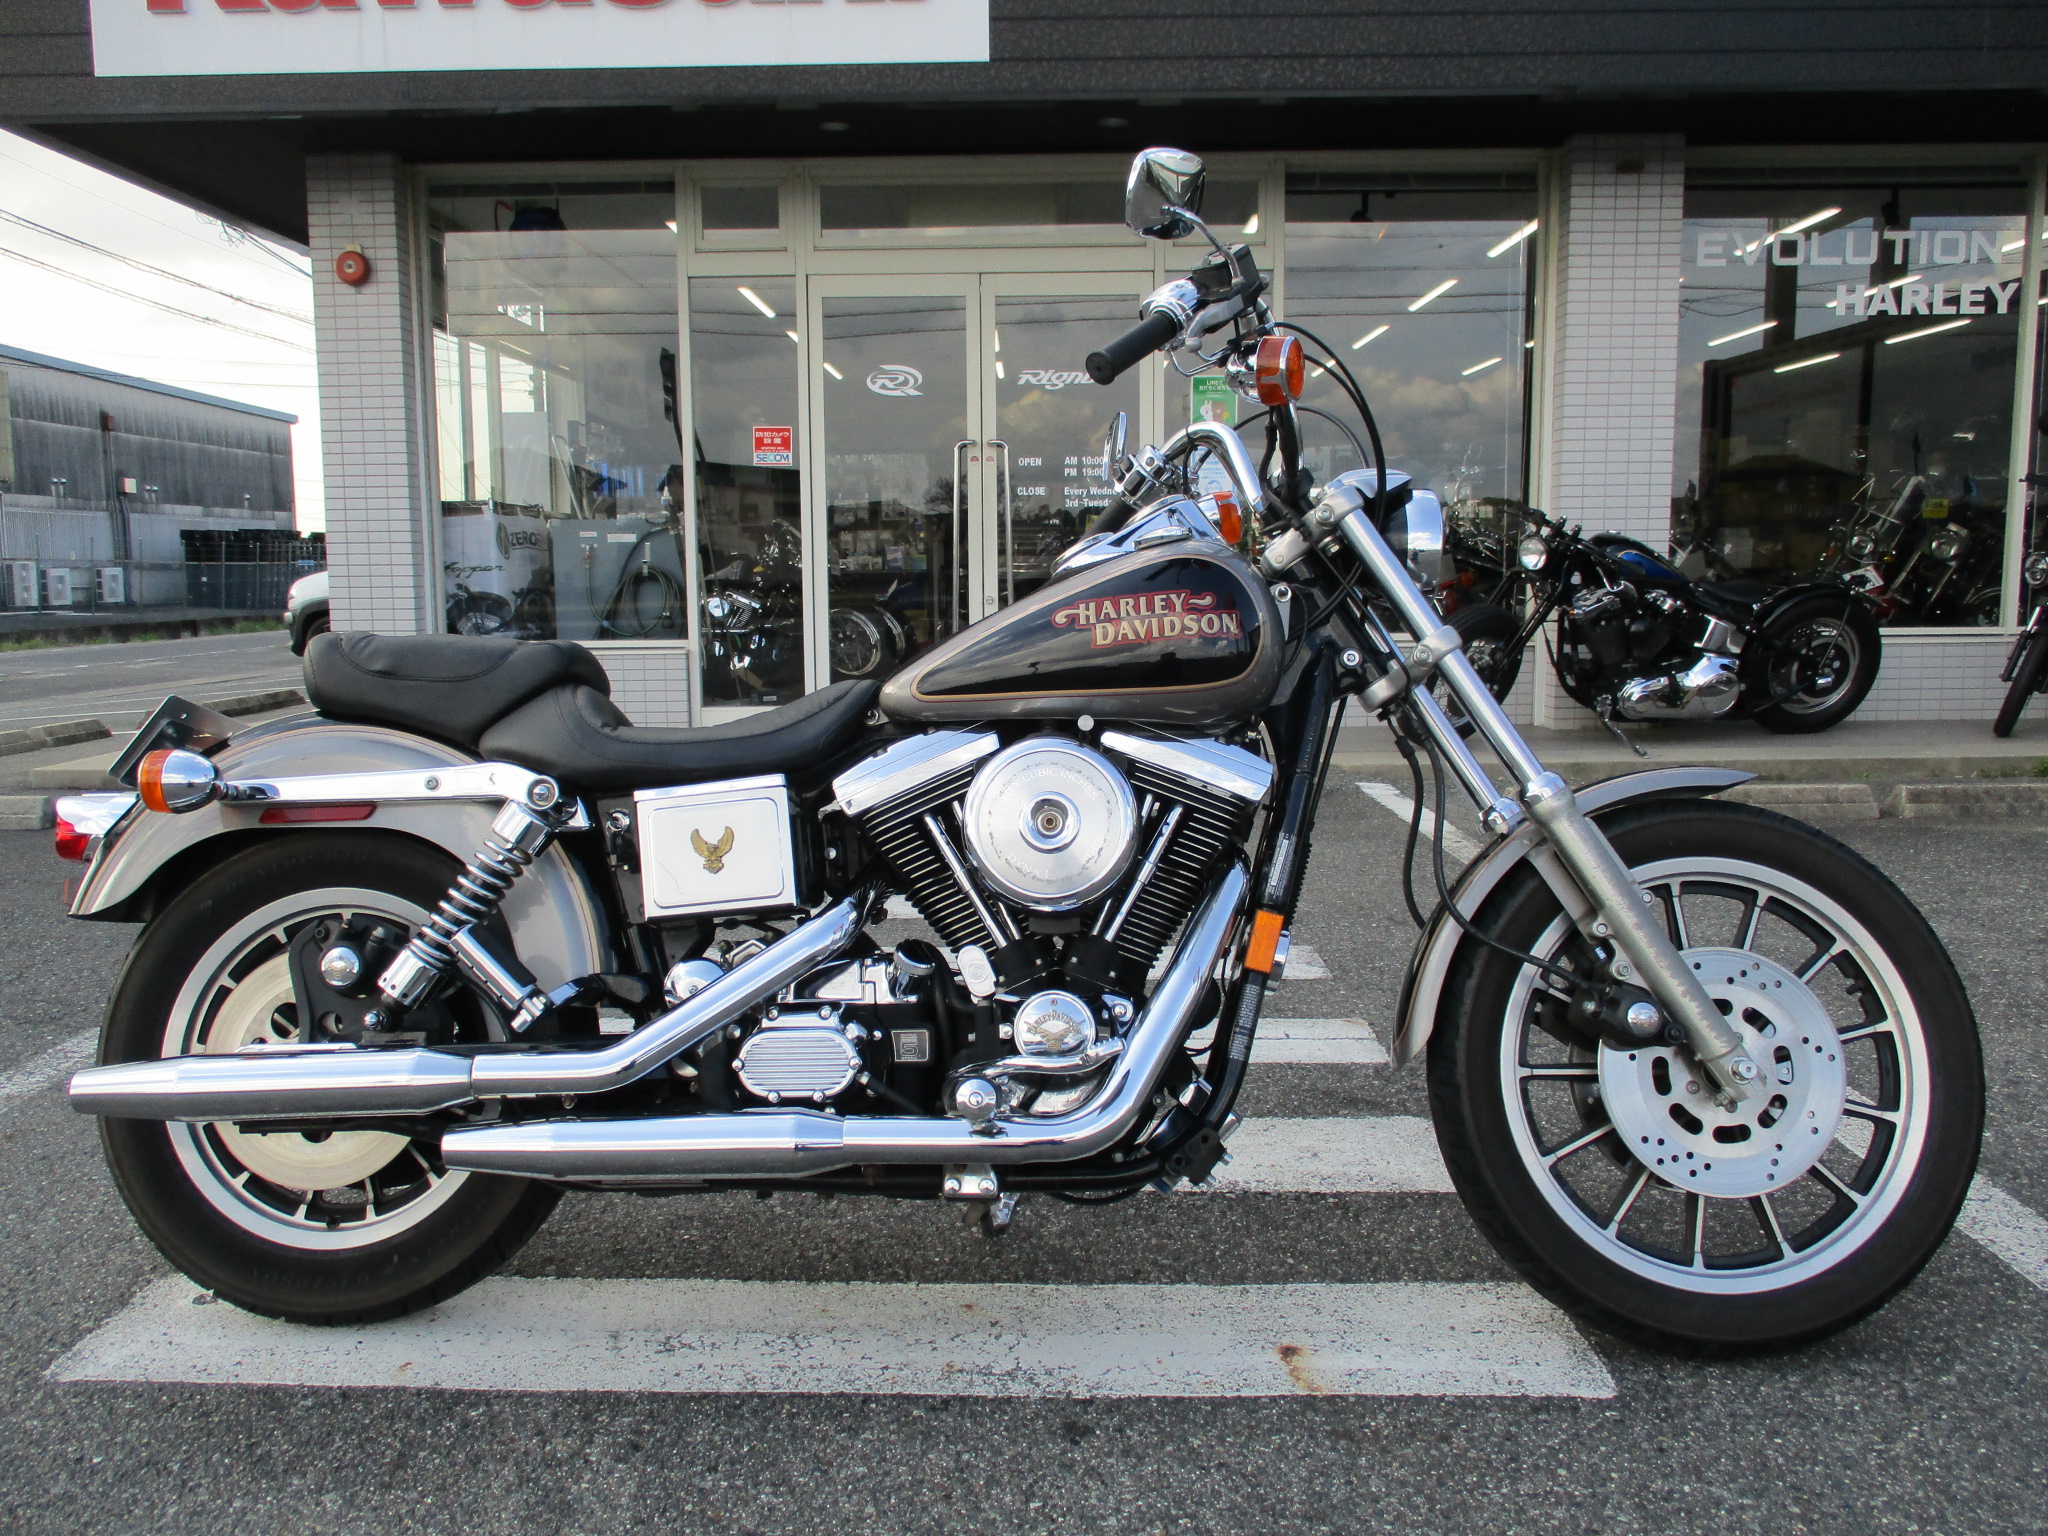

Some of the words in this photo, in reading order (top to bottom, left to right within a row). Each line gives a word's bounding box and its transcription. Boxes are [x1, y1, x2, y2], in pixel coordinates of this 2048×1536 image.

[1697, 231, 2002, 267] EVOLUTION
[1835, 282, 2020, 316] HARLEY
[756, 453, 790, 463] SECOM
[1018, 457, 1042, 467] OPEN
[1064, 456, 1078, 465] AM
[1081, 456, 1104, 465] 10:00
[1064, 468, 1078, 477] PM
[1082, 467, 1104, 477] 19:00
[1017, 486, 1046, 496] CLOSE
[1064, 486, 1088, 498] Every
[1055, 592, 1213, 626] HARLEY
[1093, 612, 1240, 648] DAVIDSON
[1022, 767, 1059, 782] CUBIC
[1061, 767, 1099, 801] INCHES
